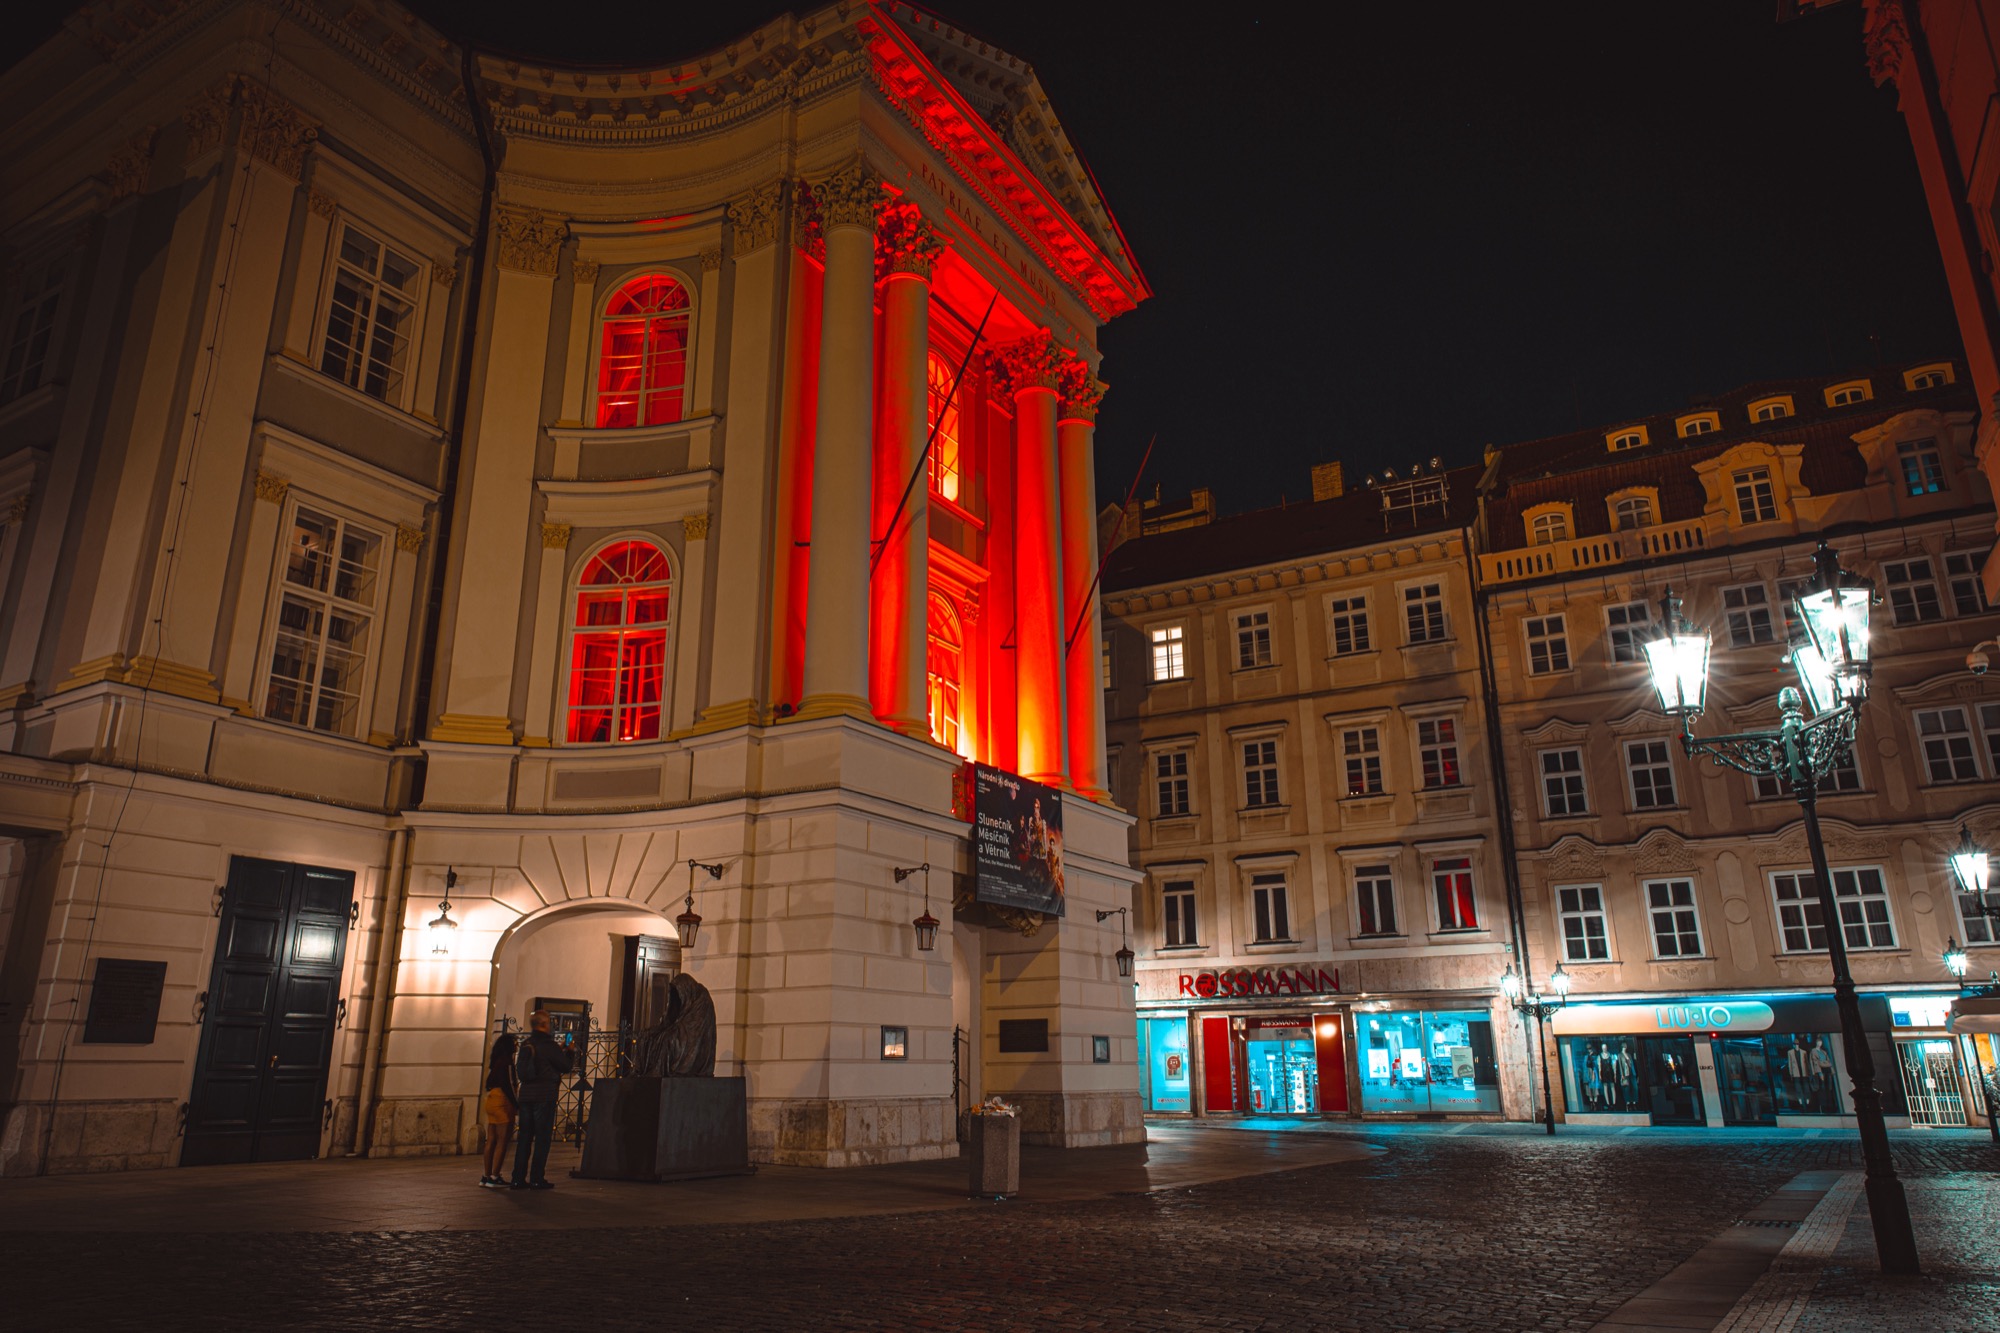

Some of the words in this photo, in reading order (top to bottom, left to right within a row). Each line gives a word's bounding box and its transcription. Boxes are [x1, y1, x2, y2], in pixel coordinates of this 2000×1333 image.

[922, 163, 982, 233] PATRIAE
[993, 233, 1009, 258] ET
[1020, 259, 1057, 306] MUSIS
[977, 769, 998, 783] Národní
[1003, 778, 1021, 791] divadlo
[978, 812, 1014, 833] Slunečník,
[978, 827, 1010, 845] Měsíčník
[978, 844, 983, 853] a
[984, 843, 1010, 859] Větrník
[1179, 968, 1340, 998] ROSSMANN
